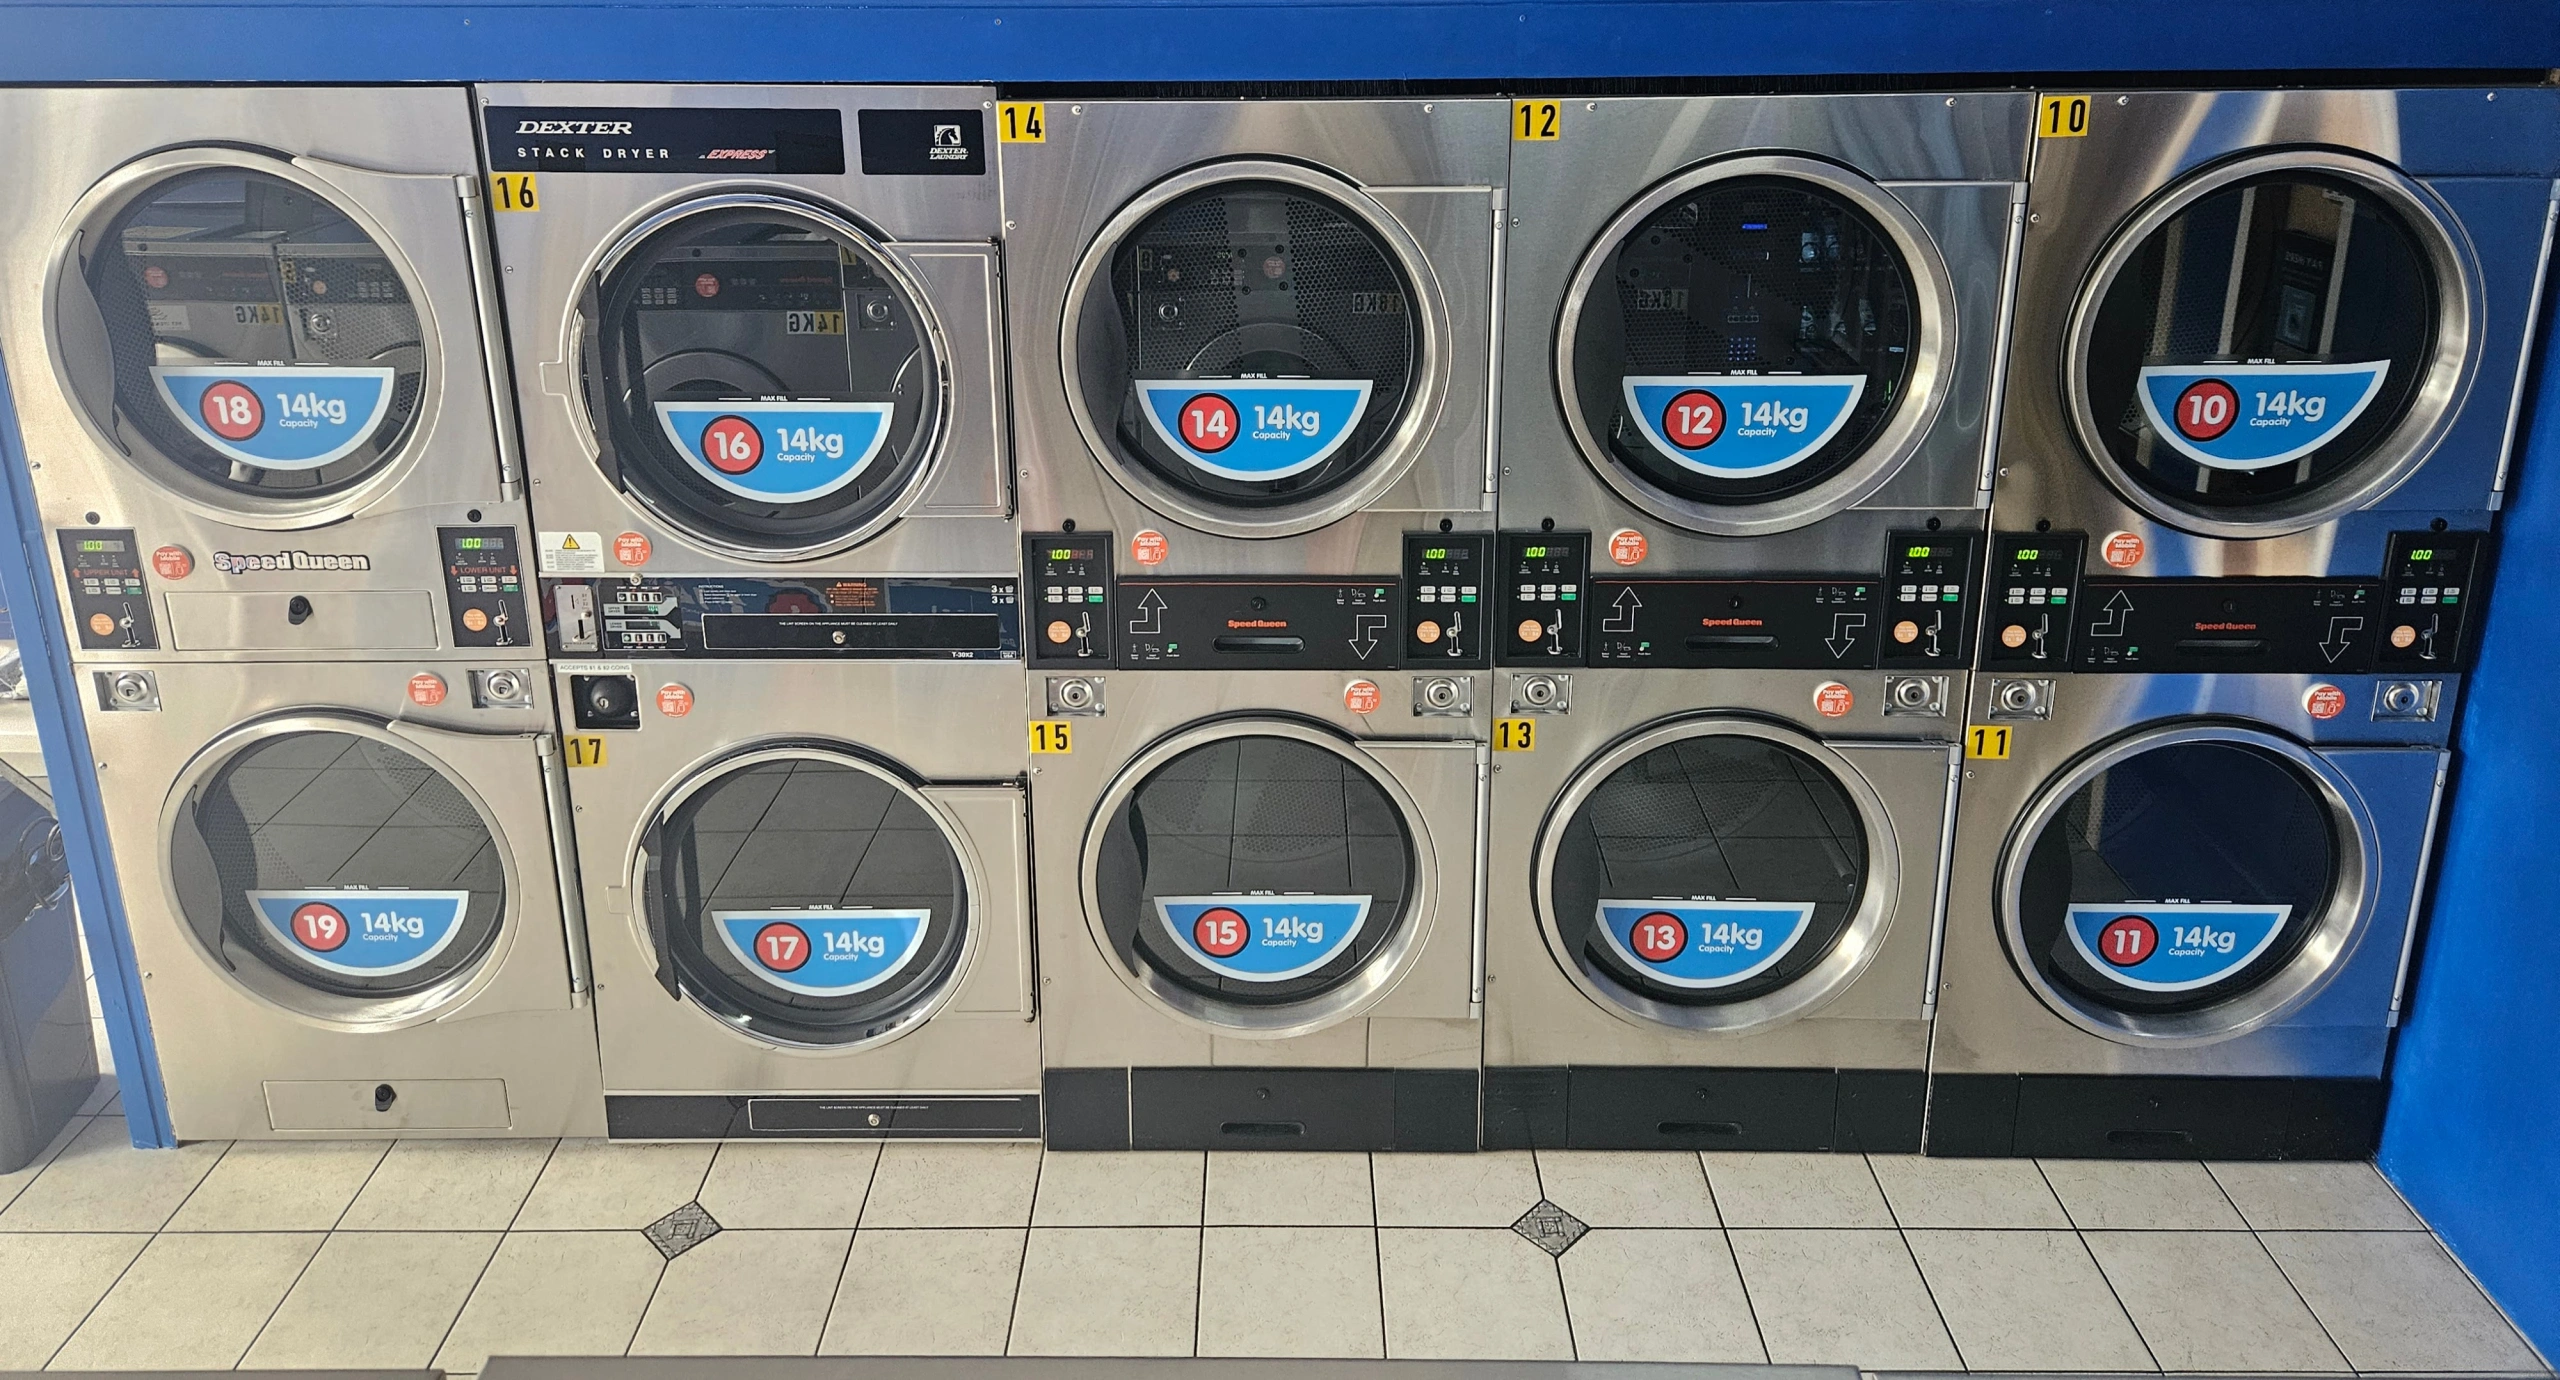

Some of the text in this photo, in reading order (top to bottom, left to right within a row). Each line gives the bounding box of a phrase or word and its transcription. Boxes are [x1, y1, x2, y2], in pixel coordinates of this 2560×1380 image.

[516, 121, 633, 135] DEXTER
[1005, 107, 1042, 139] 14
[1521, 104, 1556, 137] 12
[2050, 99, 2086, 133] 10
[517, 148, 670, 159] STACK DRYER
[706, 150, 767, 160] EXPRESS
[496, 176, 534, 210] 16
[213, 395, 252, 425] 18
[277, 392, 346, 424] 14kg
[1678, 405, 1713, 434] 12
[1741, 400, 1809, 432] 14kg
[2189, 394, 2227, 425] 10
[2255, 390, 2326, 422] 14kg
[279, 418, 318, 429] Capacity
[1192, 410, 1229, 438] 14
[1254, 404, 1320, 436] 14kg
[1738, 426, 1777, 438] Capacity
[2250, 416, 2292, 427] Capacity
[714, 431, 751, 460] 16
[777, 427, 844, 458] 14kg
[1253, 430, 1291, 442] Capacity
[777, 452, 815, 463] Capacity
[213, 550, 371, 574] Speed Queen
[992, 585, 998, 593] 3
[992, 596, 998, 604] 3
[1036, 724, 1068, 751] 15
[1500, 722, 1531, 749] 13
[1974, 729, 2007, 756] 11
[570, 738, 601, 765] 17
[304, 914, 338, 940] 19
[361, 911, 425, 938] 14kg
[1205, 920, 1238, 946] 15
[1263, 916, 1324, 943] 14kg
[1644, 925, 1676, 950] 13
[1702, 923, 1763, 950] 14kg
[362, 934, 398, 943] Capacity
[766, 936, 799, 961] 17
[823, 930, 885, 957] 14kg
[1262, 939, 1297, 948] Capacity
[1699, 945, 1735, 954] Capacity
[2114, 930, 2141, 955] 11
[2174, 925, 2236, 954] 14kg
[823, 953, 859, 962] Capacity
[2169, 948, 2206, 957] Capacity
